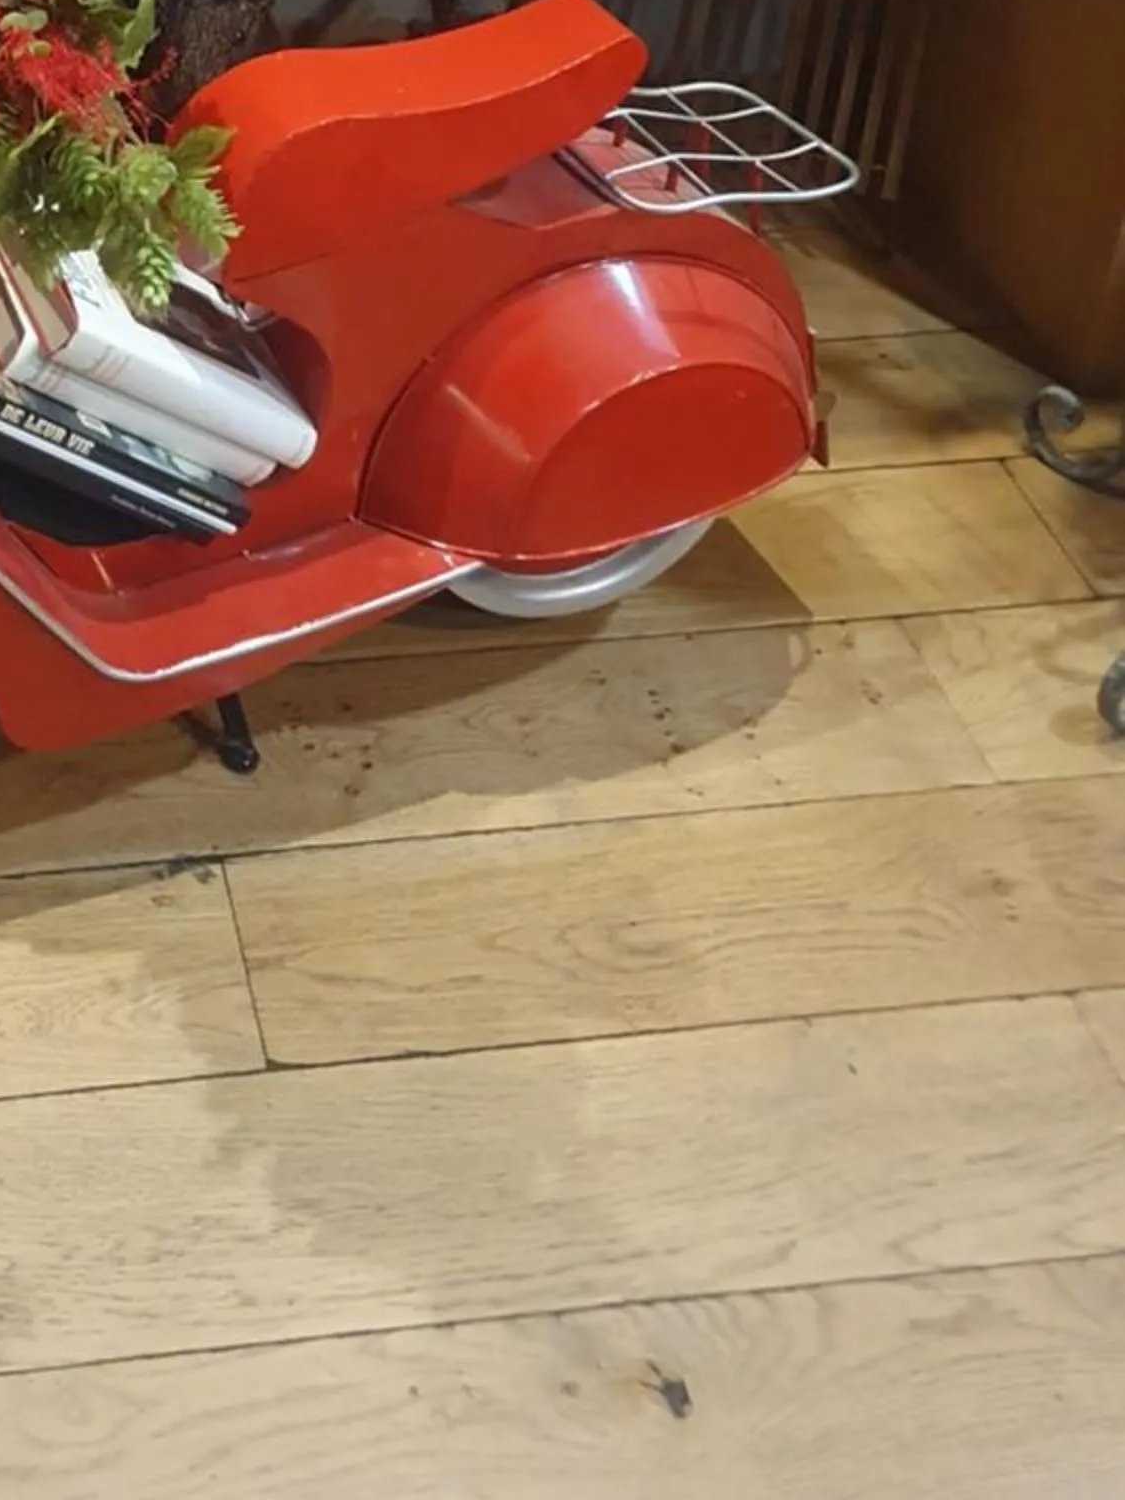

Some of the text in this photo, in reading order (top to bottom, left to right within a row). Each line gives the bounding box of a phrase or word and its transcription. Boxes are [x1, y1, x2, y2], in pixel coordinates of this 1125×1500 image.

[0, 402, 26, 425] DE
[24, 413, 68, 443] LEUR
[68, 433, 94, 456] VIE
